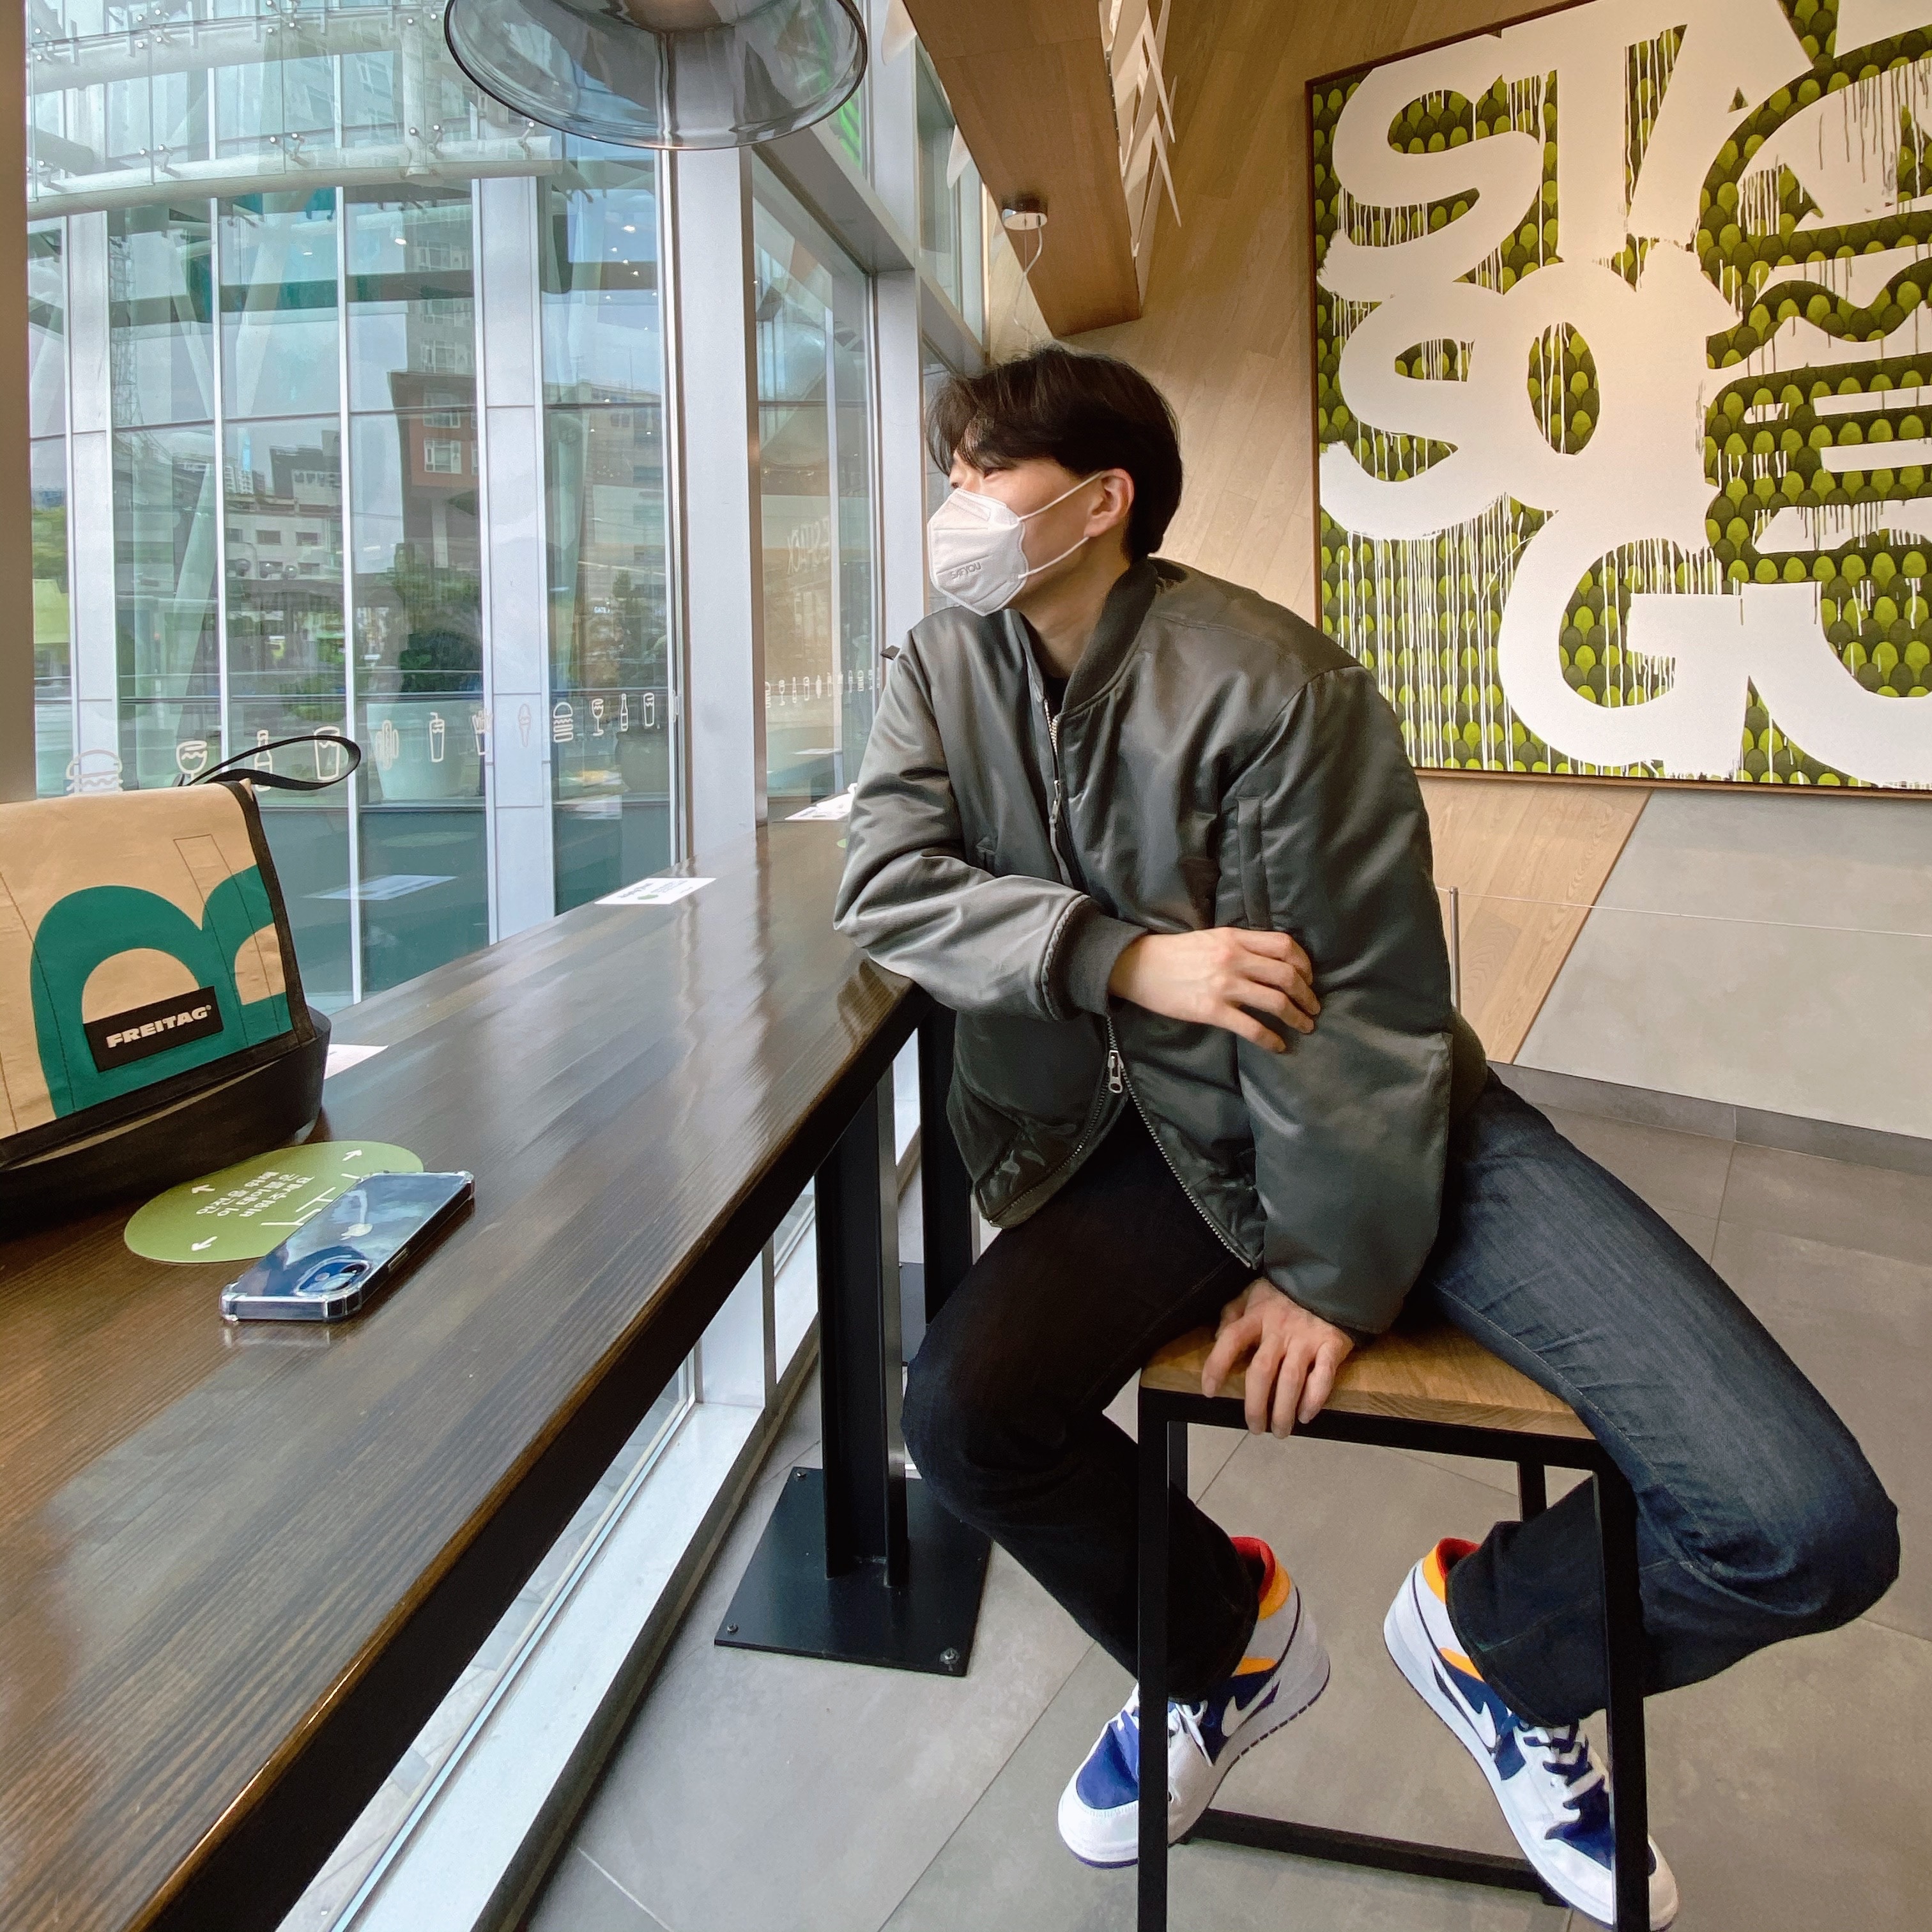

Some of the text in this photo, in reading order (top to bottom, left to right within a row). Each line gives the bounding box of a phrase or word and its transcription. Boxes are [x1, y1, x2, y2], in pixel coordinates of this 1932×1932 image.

[106, 1006, 209, 1048] FREITAG
[196, 1171, 279, 1214] 안전을 위해
[217, 1174, 300, 1217] 이 테이블은
[239, 1176, 315, 1217] 비워주세요
